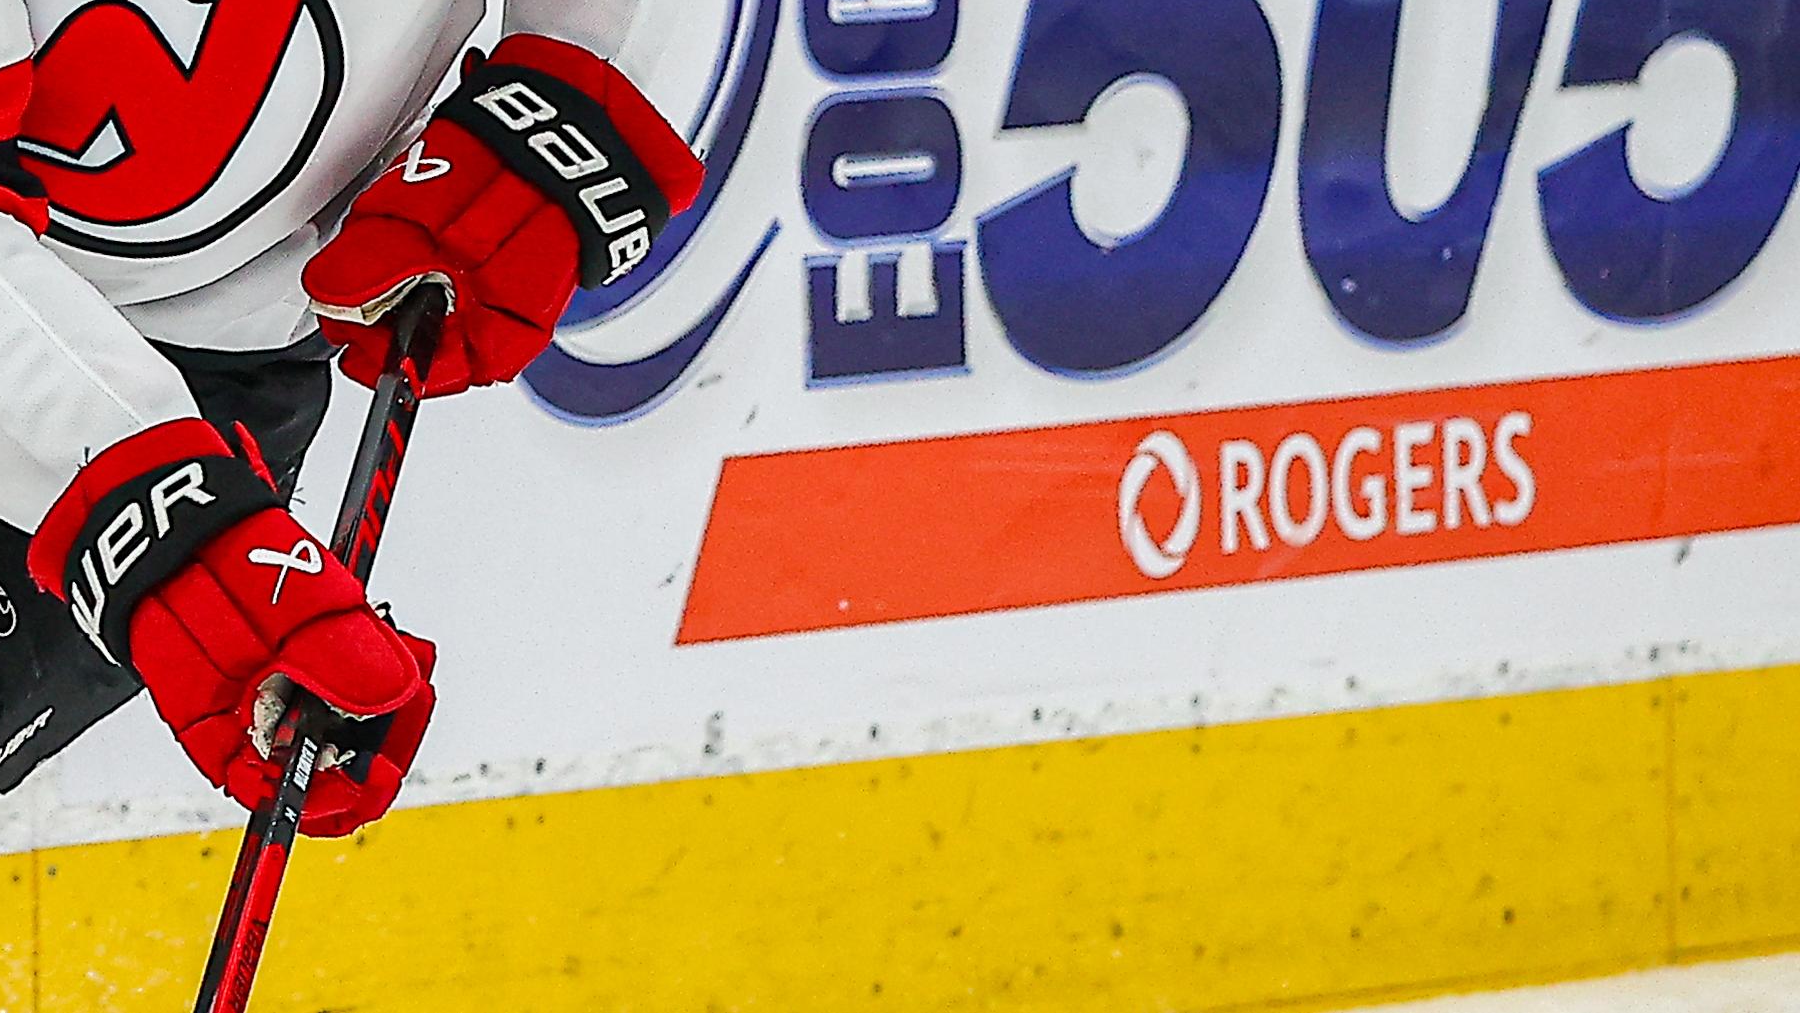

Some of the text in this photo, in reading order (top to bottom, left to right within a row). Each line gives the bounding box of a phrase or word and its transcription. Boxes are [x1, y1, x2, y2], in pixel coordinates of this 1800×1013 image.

[472, 80, 652, 287] BAUE
[69, 461, 218, 668] UER
[1218, 410, 1537, 555] ROGERS
